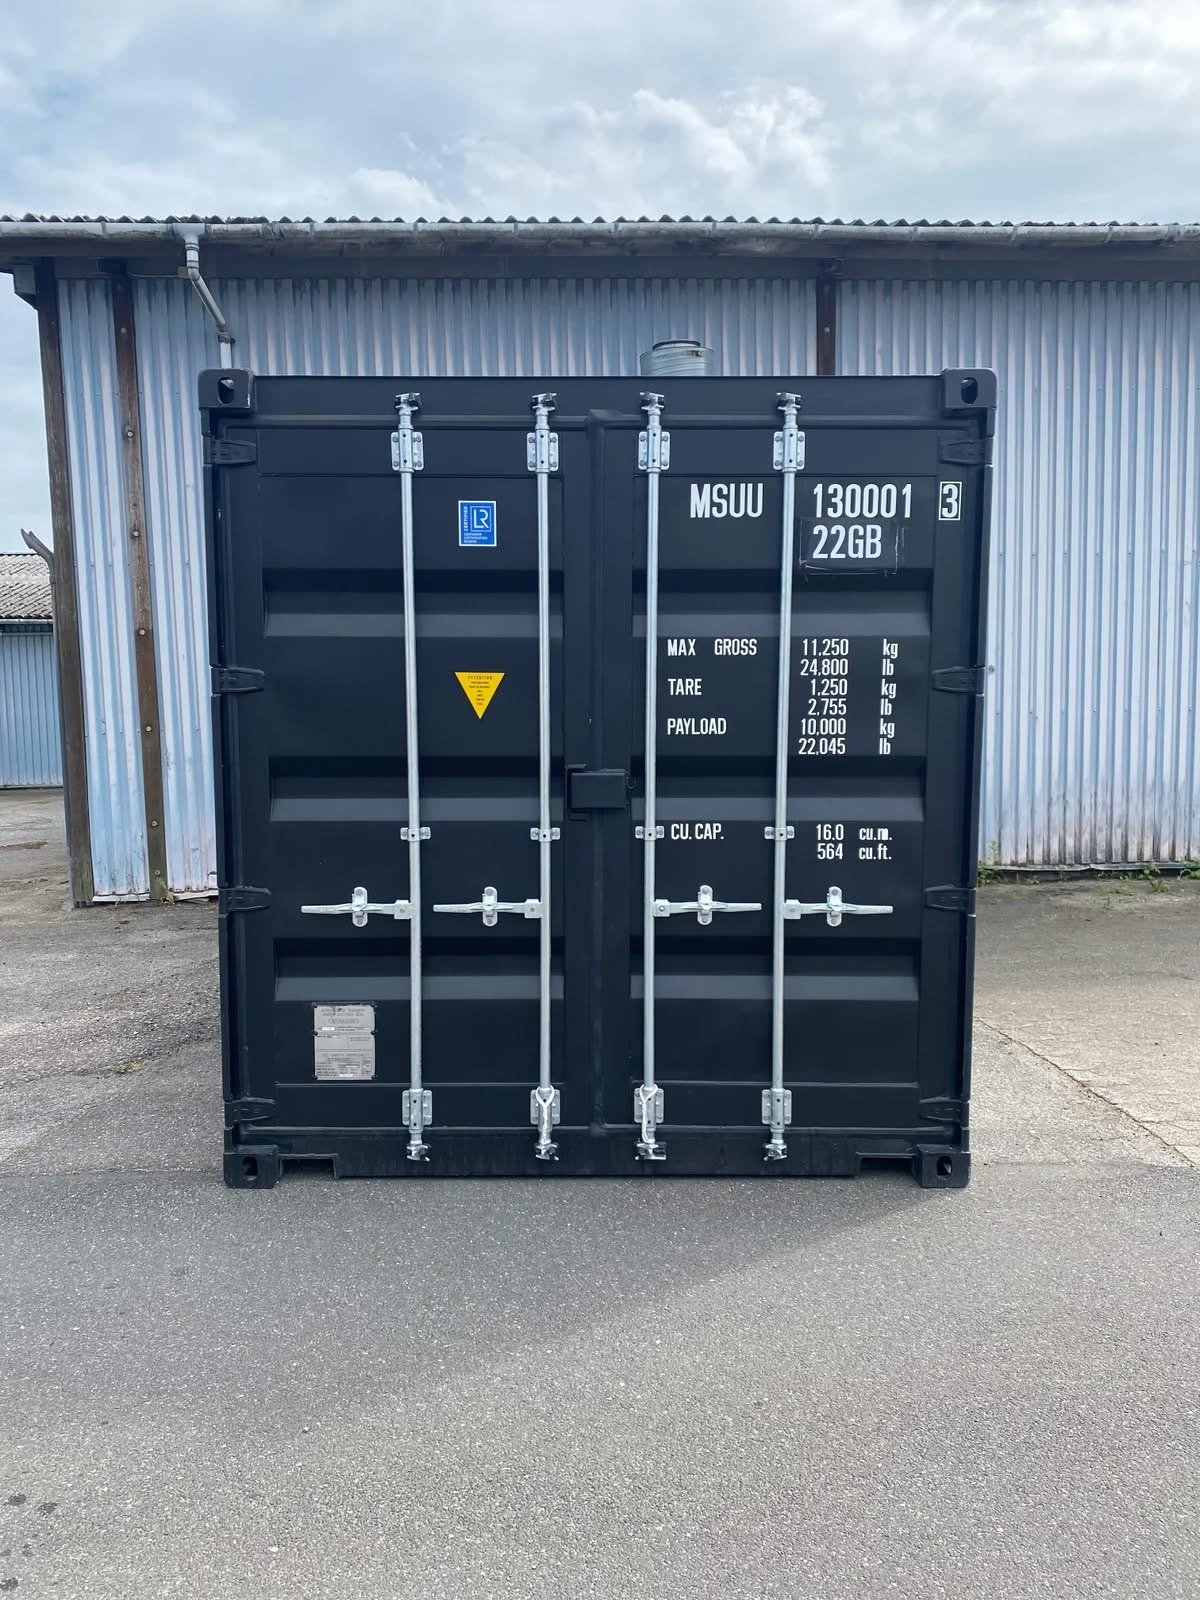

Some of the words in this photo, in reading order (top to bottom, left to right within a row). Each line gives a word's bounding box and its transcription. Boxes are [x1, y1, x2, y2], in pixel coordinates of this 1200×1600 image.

[690, 482, 764, 519] MSUU
[813, 483, 912, 519] 130001
[941, 484, 959, 518] 3
[473, 508, 489, 528] LR
[812, 524, 882, 559] 22GB
[667, 638, 697, 657] MAX
[714, 638, 758, 656] GROSS
[802, 638, 850, 657] 11,250
[882, 638, 899, 660] kg
[799, 658, 849, 677] 24,800
[882, 658, 895, 676] lb
[668, 678, 703, 696] TARE
[810, 678, 848, 697] 1,250
[881, 678, 897, 700] kg
[807, 697, 847, 716] 2,755
[880, 697, 893, 716] lb
[667, 717, 727, 736] PAYLOAD
[800, 717, 847, 736] 10,000
[879, 717, 896, 739] kg
[798, 737, 846, 756] 22,045
[879, 736, 892, 755] lb
[815, 823, 845, 841] 16.0
[817, 842, 844, 860] 564
[858, 842, 892, 860] cu.ft.
